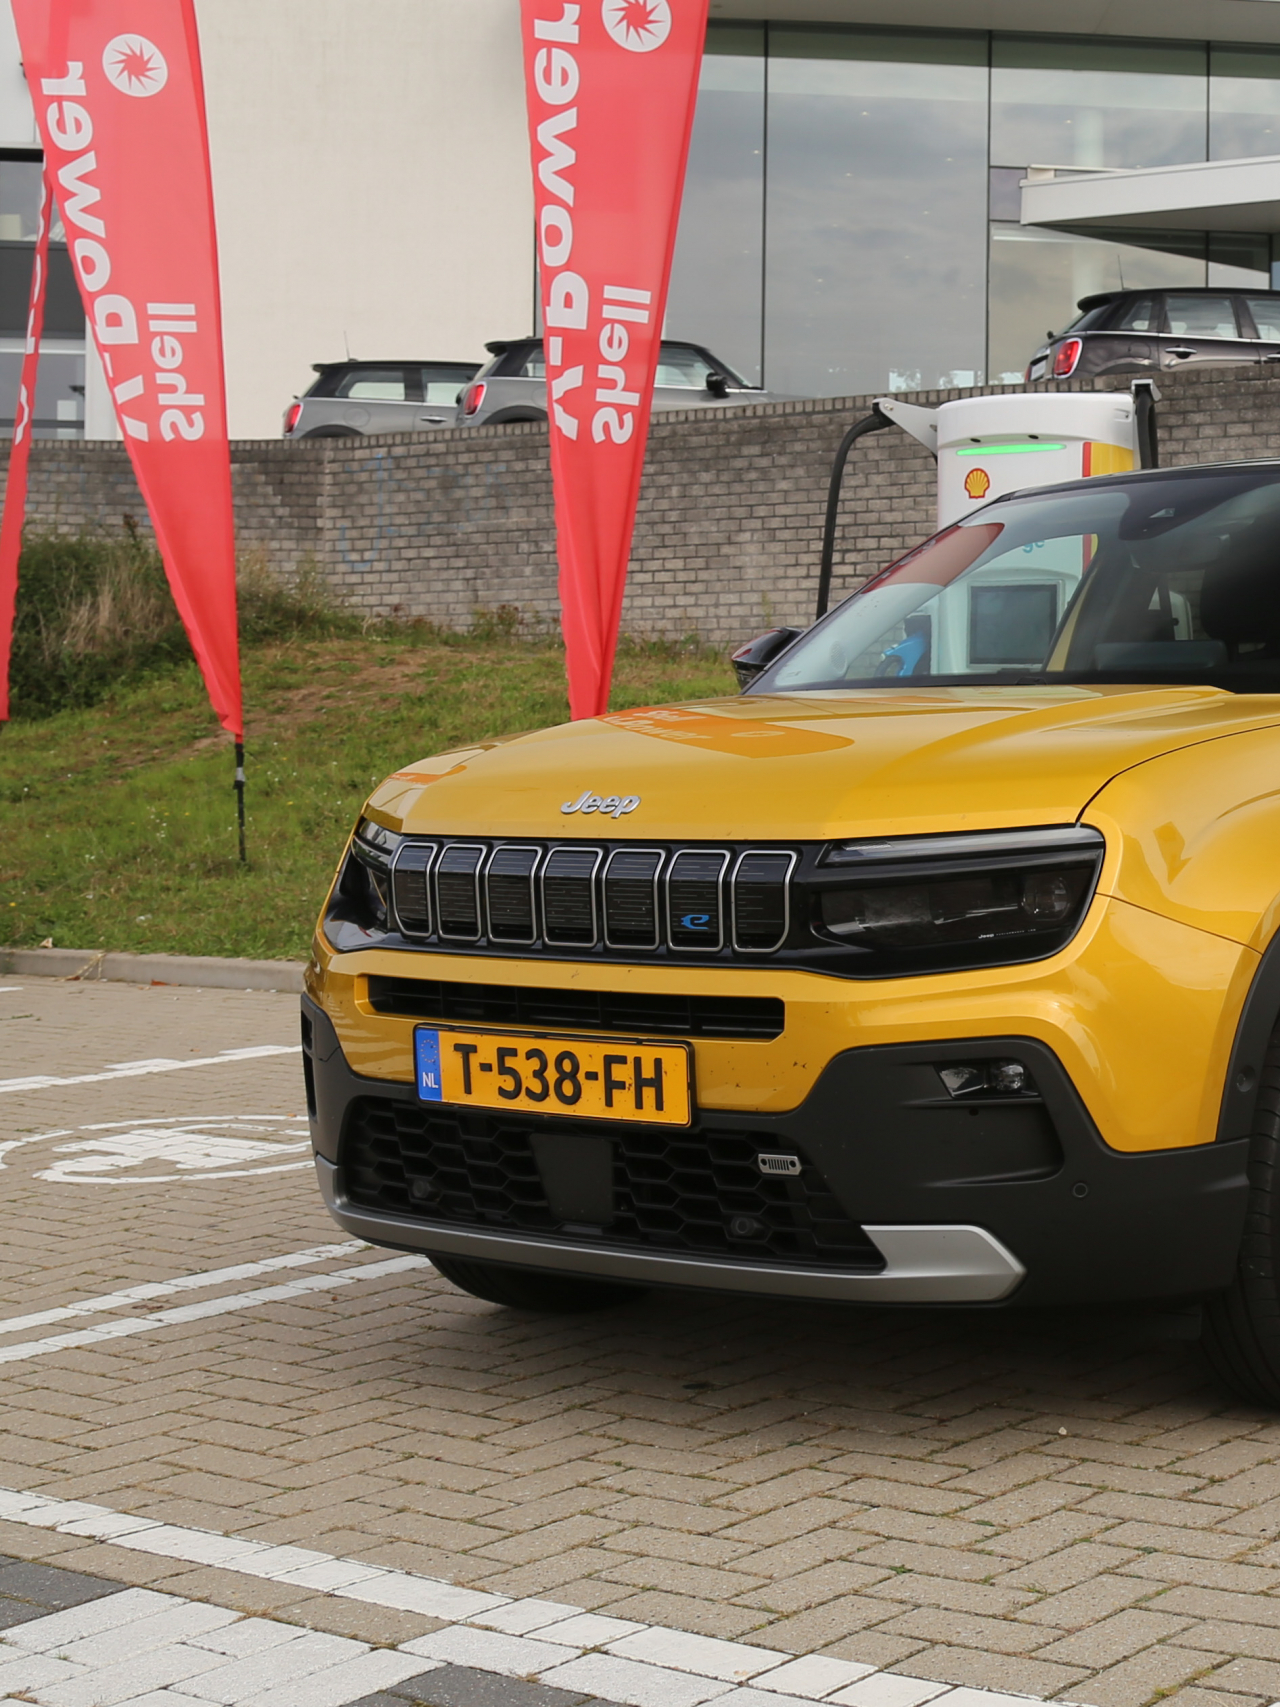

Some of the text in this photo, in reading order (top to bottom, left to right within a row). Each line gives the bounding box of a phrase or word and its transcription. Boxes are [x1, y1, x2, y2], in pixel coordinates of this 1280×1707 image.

[560, 790, 642, 819] Jeep
[422, 1071, 439, 1089] NL
[453, 1043, 664, 1112] T-538-FH
